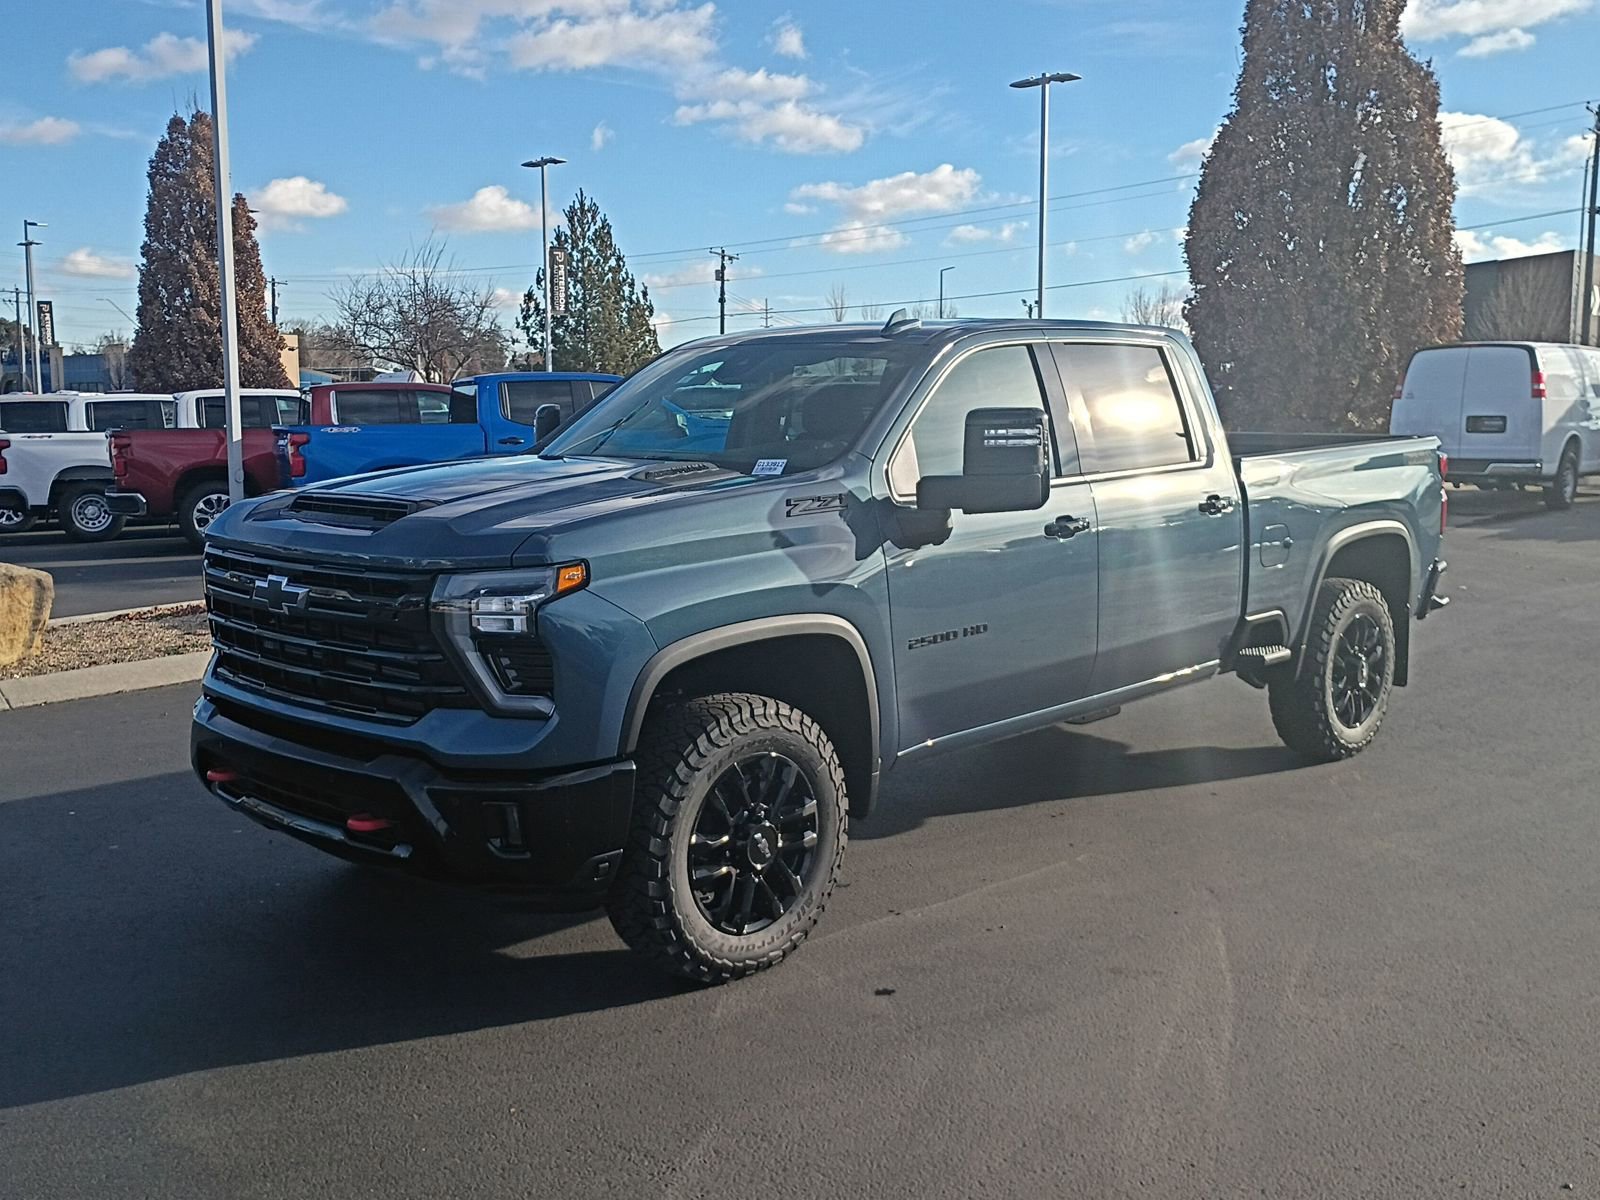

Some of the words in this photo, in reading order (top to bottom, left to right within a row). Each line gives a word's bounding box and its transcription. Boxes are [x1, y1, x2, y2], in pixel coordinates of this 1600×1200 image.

[558, 264, 566, 311] PETERSON
[785, 493, 848, 518] Z71
[907, 629, 959, 651] 2500
[962, 622, 988, 638] HD
